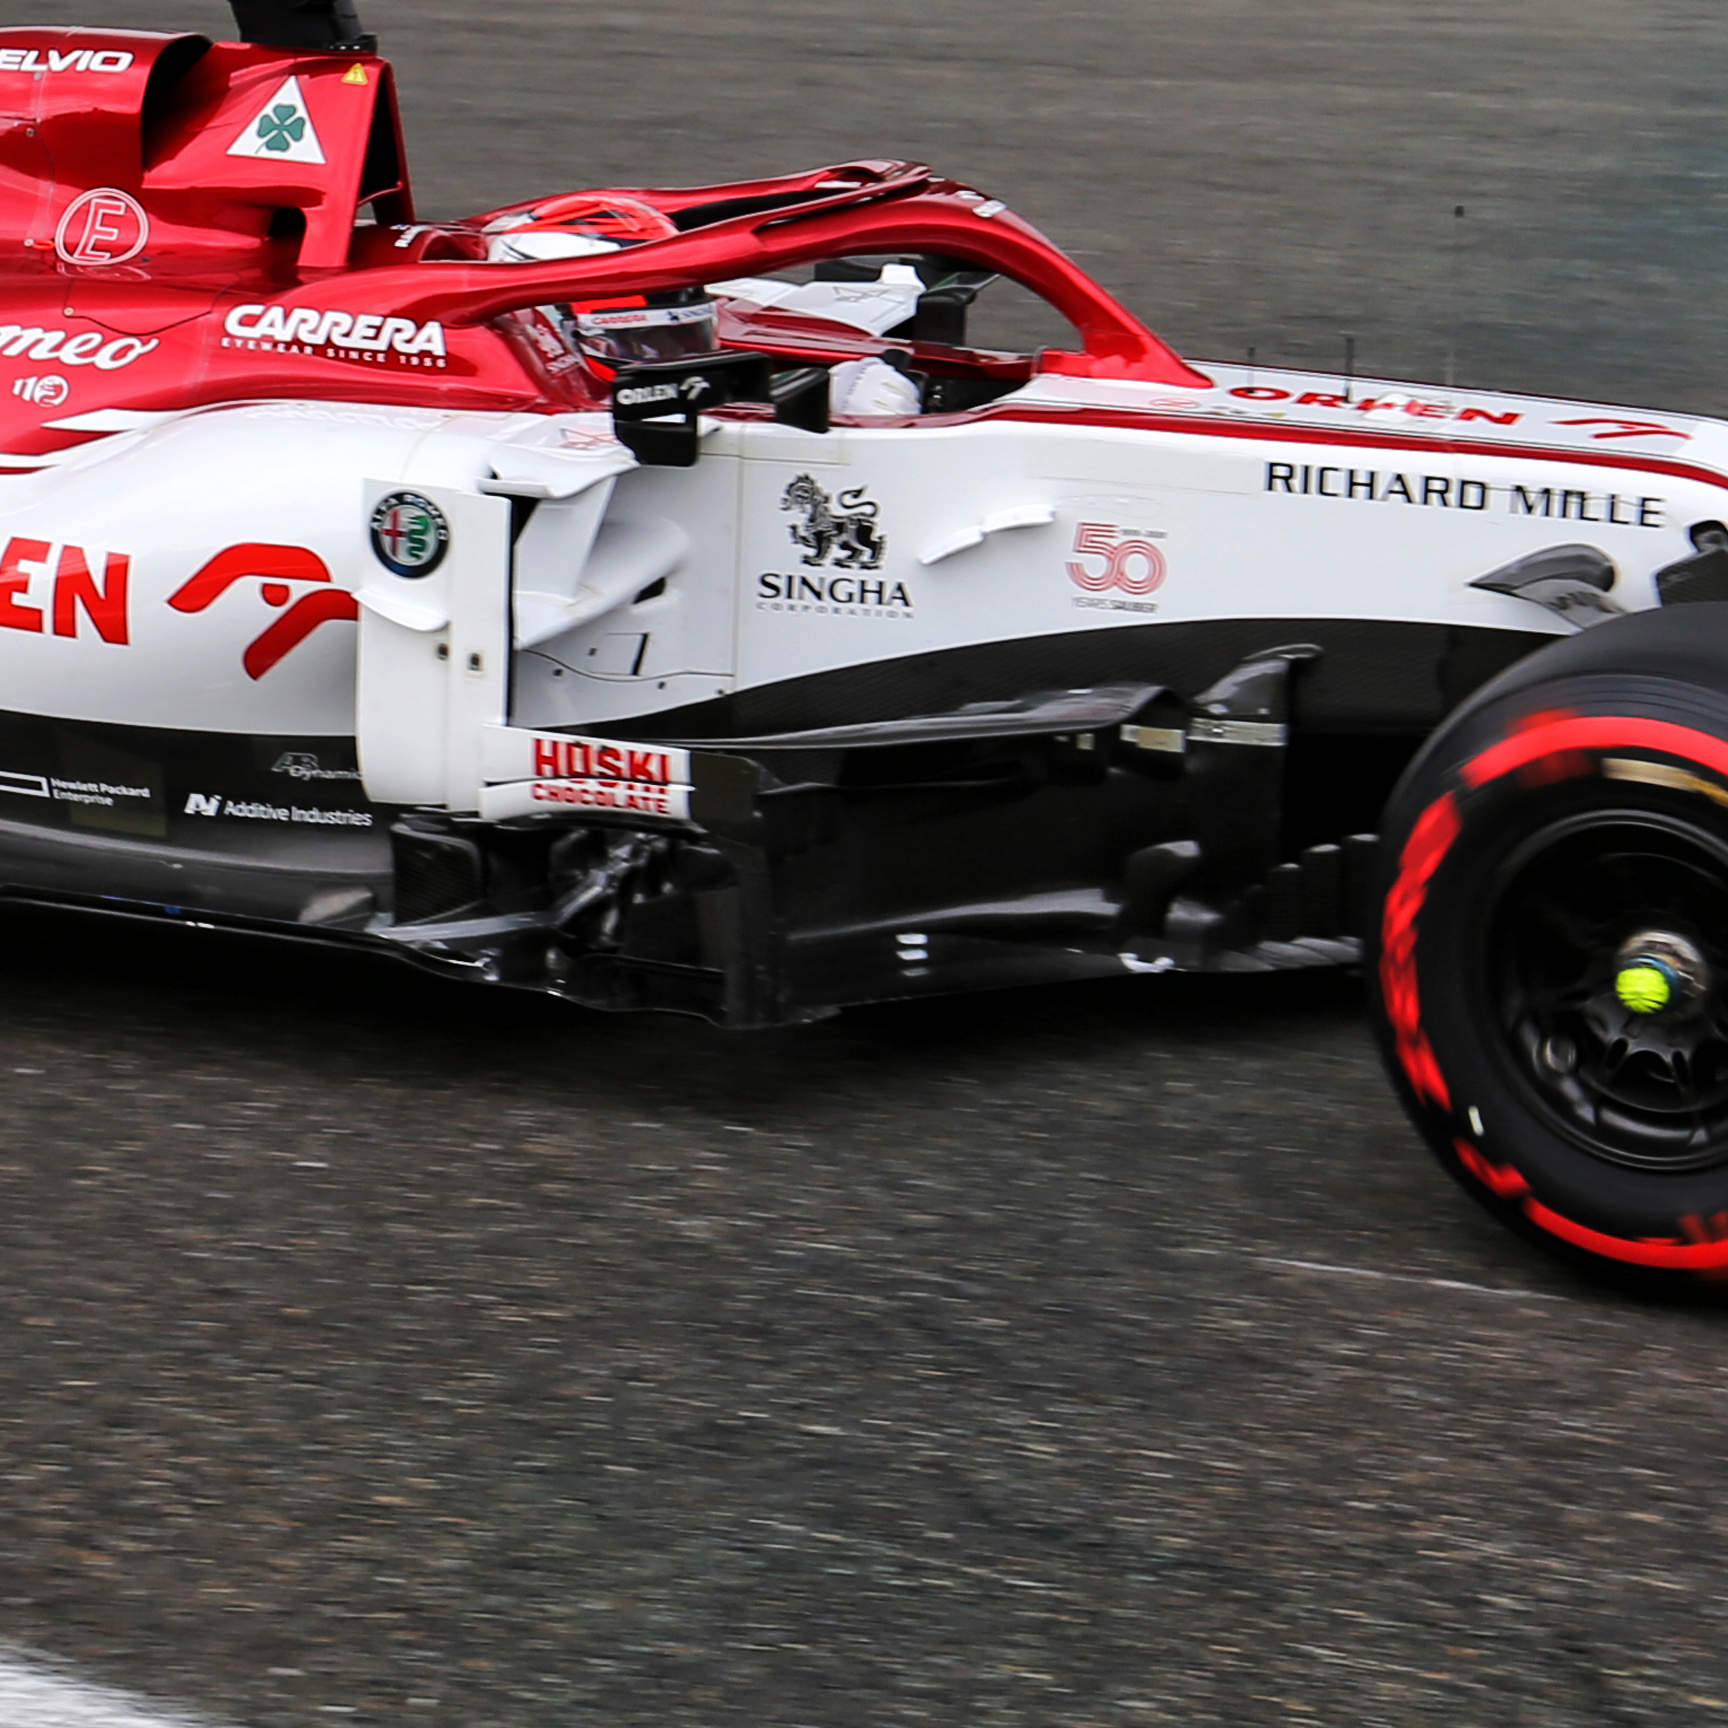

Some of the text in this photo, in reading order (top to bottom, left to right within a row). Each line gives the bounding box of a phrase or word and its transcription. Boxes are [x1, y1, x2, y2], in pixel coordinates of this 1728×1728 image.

[224, 304, 446, 356] CARRERA
[221, 336, 447, 368] EYEWEAR SINCE 1956
[617, 383, 678, 405] ORLEN
[1262, 461, 1668, 529] RICHARD MILLE
[1065, 522, 1167, 595] 50
[758, 572, 914, 607] SINGHA
[756, 601, 914, 619] CORPORATION
[289, 765, 363, 781] Dynamic
[533, 737, 671, 787] HUSKI
[224, 800, 289, 821] Additive
[291, 805, 373, 826] Industries
[530, 782, 670, 815] CHOCOLATE
